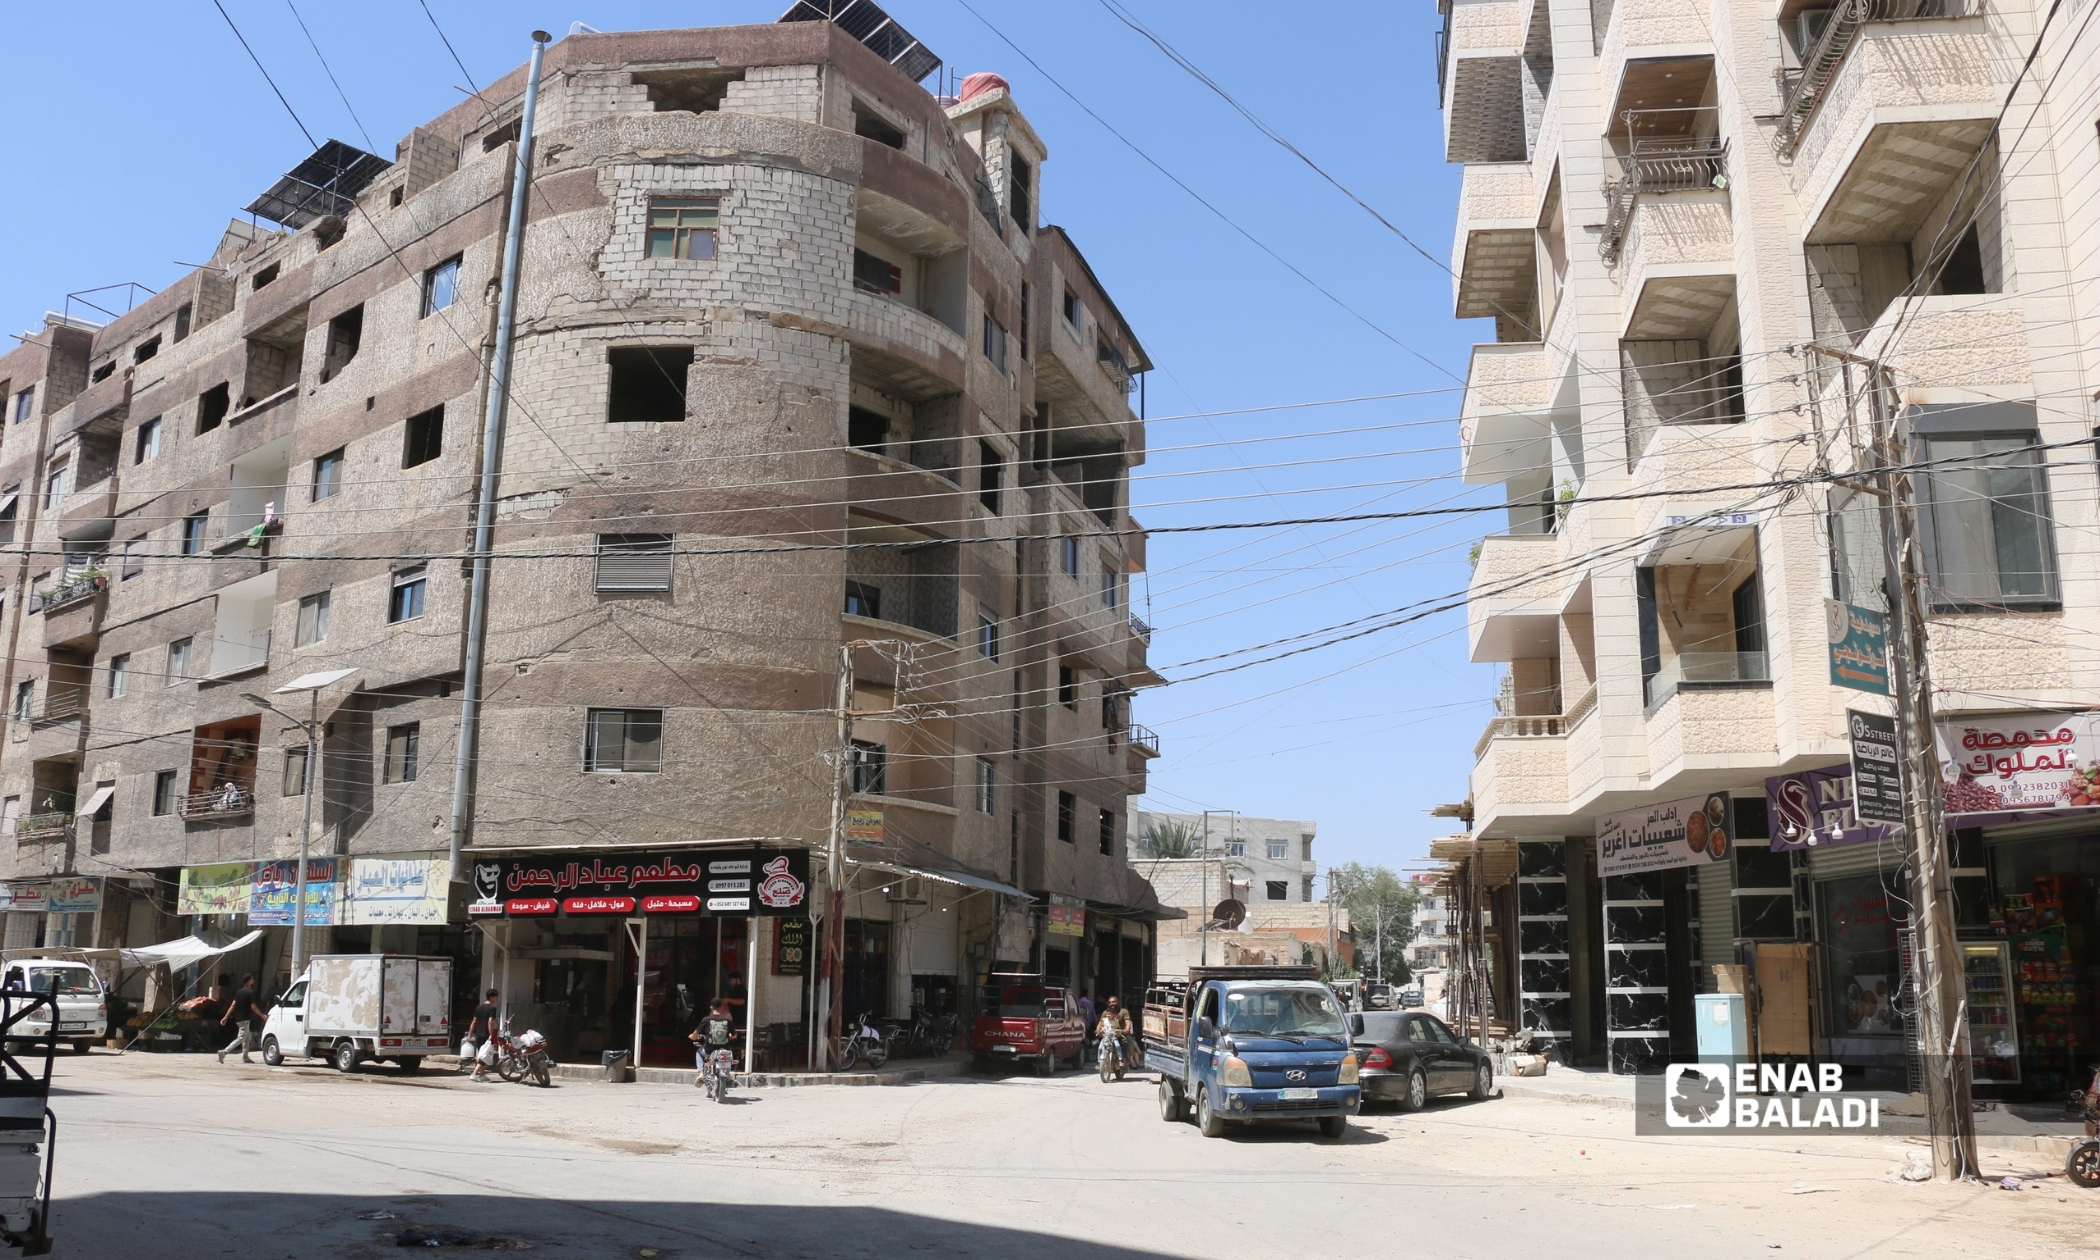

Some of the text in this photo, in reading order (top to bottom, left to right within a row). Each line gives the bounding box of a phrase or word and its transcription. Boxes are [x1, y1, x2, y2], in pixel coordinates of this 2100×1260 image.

[1849, 610, 1880, 637] صيدلية
[1834, 641, 1885, 669] توتونجي
[1962, 727, 2076, 750] محمصة
[1857, 742, 1894, 759] عالم الرياضة
[1965, 748, 2076, 780] لملوك
[1647, 806, 1677, 827] إدلب العز
[1629, 819, 1686, 852] شعيبيات
[256, 863, 286, 889] رياض
[507, 857, 700, 893] مطعم عباد الرحمن
[267, 891, 289, 906] النارية
[533, 901, 551, 910] شيش
[572, 901, 584, 909] فتة
[588, 900, 606, 909] فلافل
[647, 899, 693, 909] مسبحة متبل
[783, 917, 803, 932] مطعم
